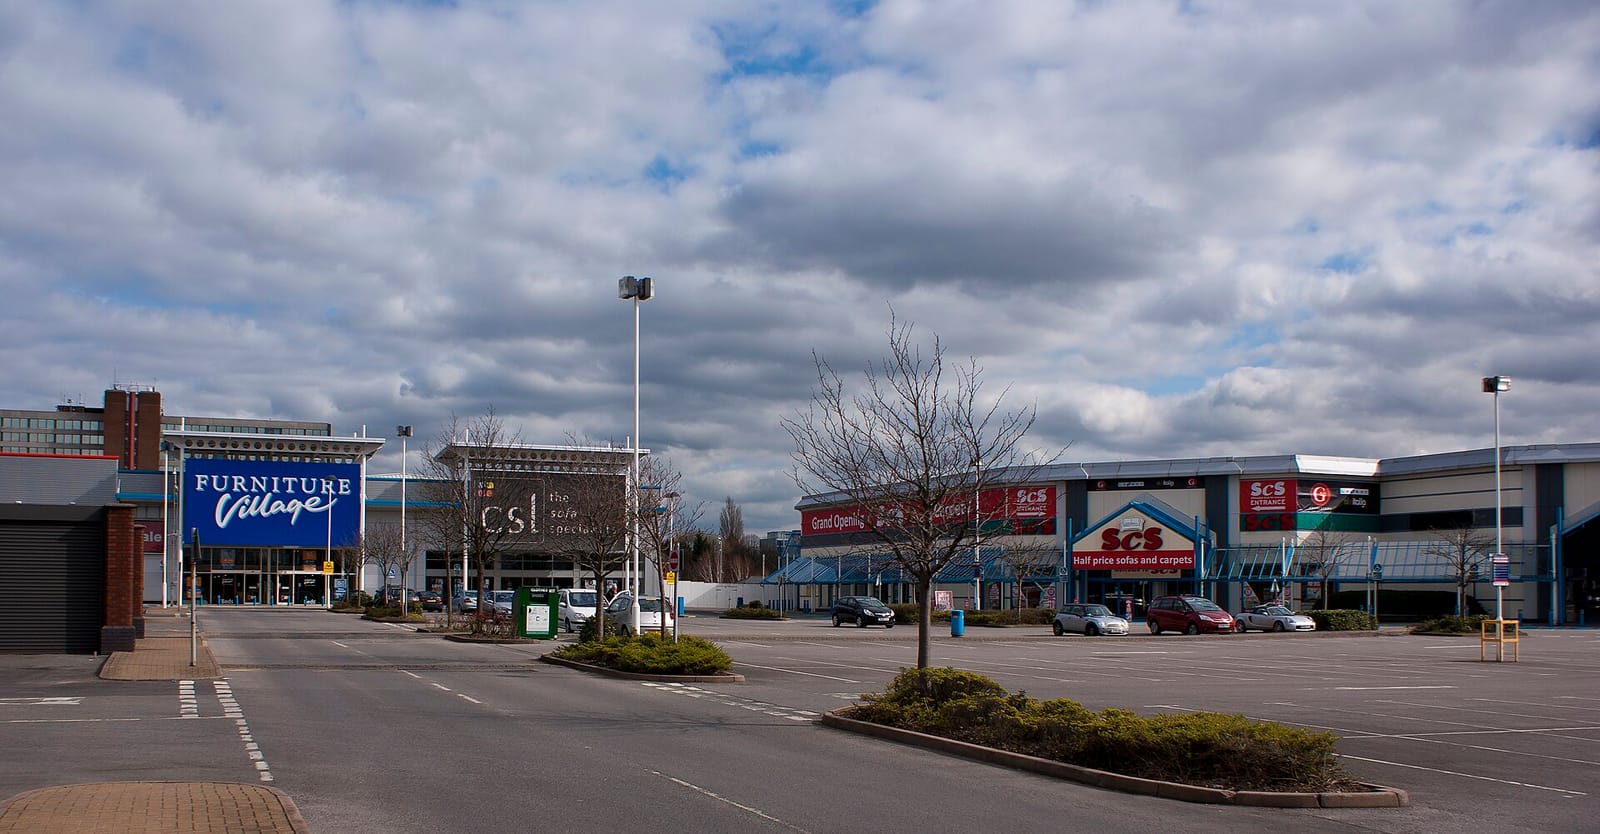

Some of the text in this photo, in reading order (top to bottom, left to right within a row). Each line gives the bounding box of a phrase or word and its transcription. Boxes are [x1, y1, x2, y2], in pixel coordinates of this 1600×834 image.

[195, 474, 351, 495] FURNITURE
[1250, 481, 1286, 497] ScS
[549, 491, 570, 503] the
[1017, 489, 1047, 503] ScS
[215, 492, 338, 529] Village
[481, 493, 539, 534] csl
[549, 507, 577, 519] sofa
[811, 516, 833, 530] Grand
[833, 513, 865, 531] Opening
[1101, 527, 1164, 550] ScS
[1073, 555, 1193, 566] Half price sofas and carpets
